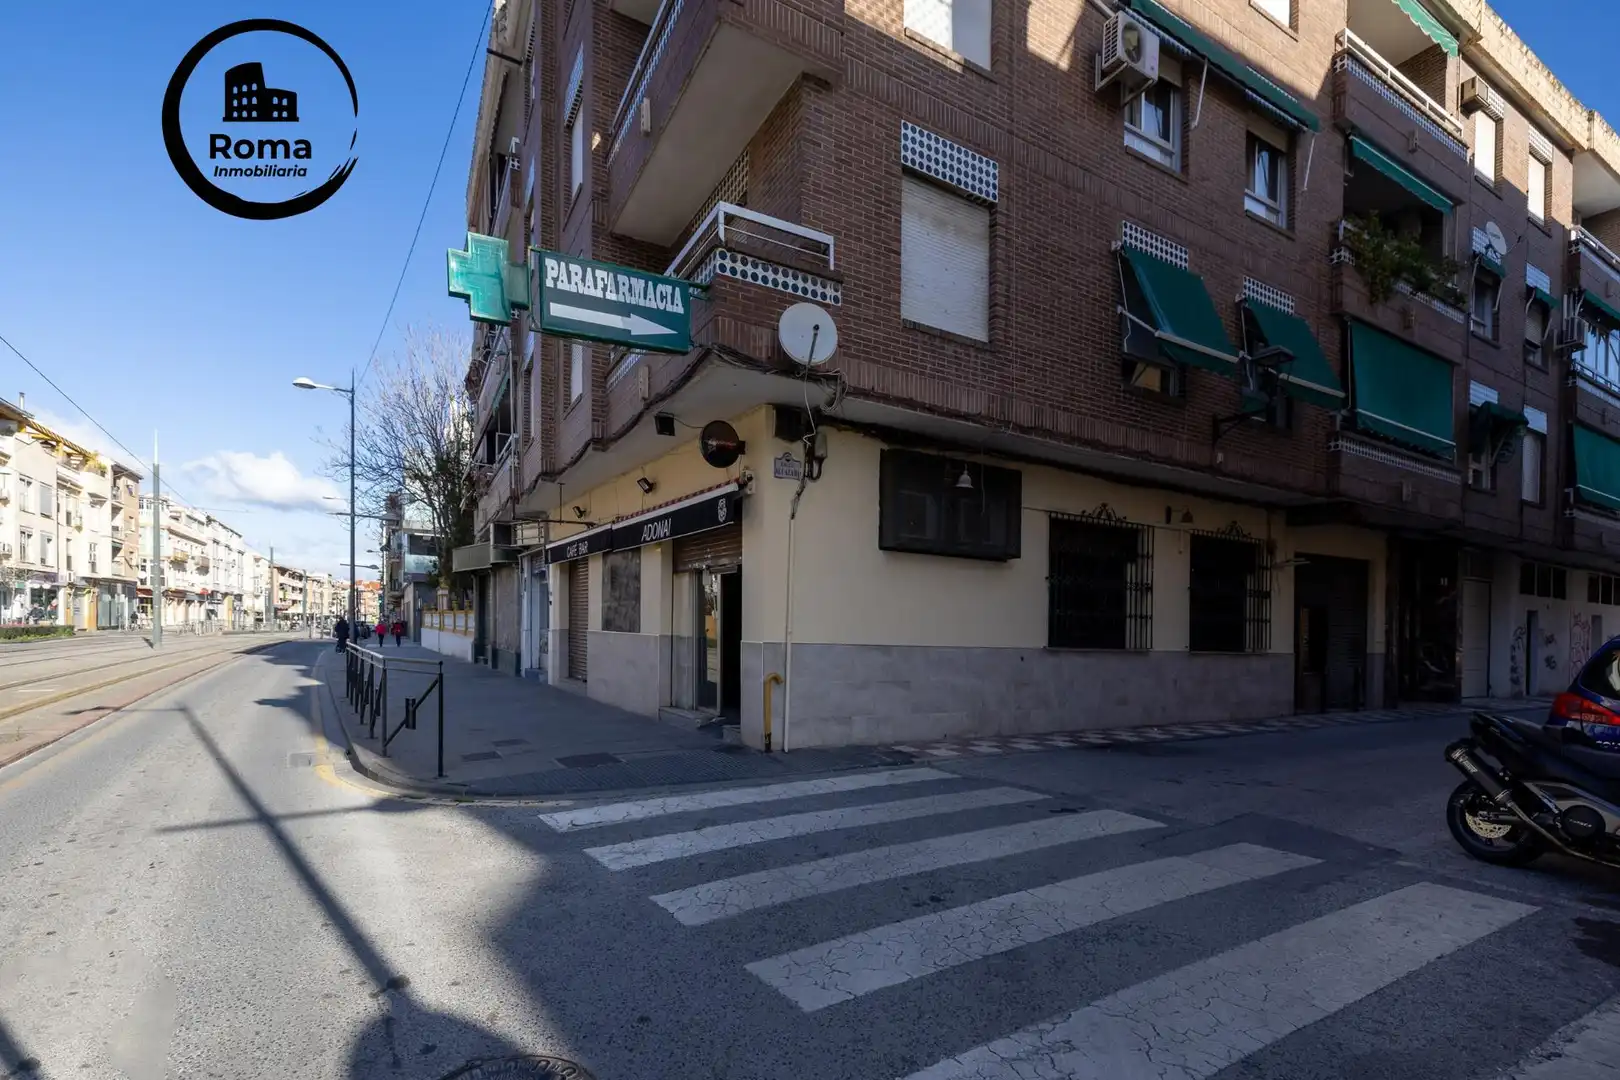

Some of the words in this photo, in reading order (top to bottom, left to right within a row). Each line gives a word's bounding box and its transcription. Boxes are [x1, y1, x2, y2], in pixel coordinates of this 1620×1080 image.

[544, 257, 685, 314] PARAFARMACIA
[641, 517, 672, 542] ADONAI
[578, 541, 589, 556] BAR
